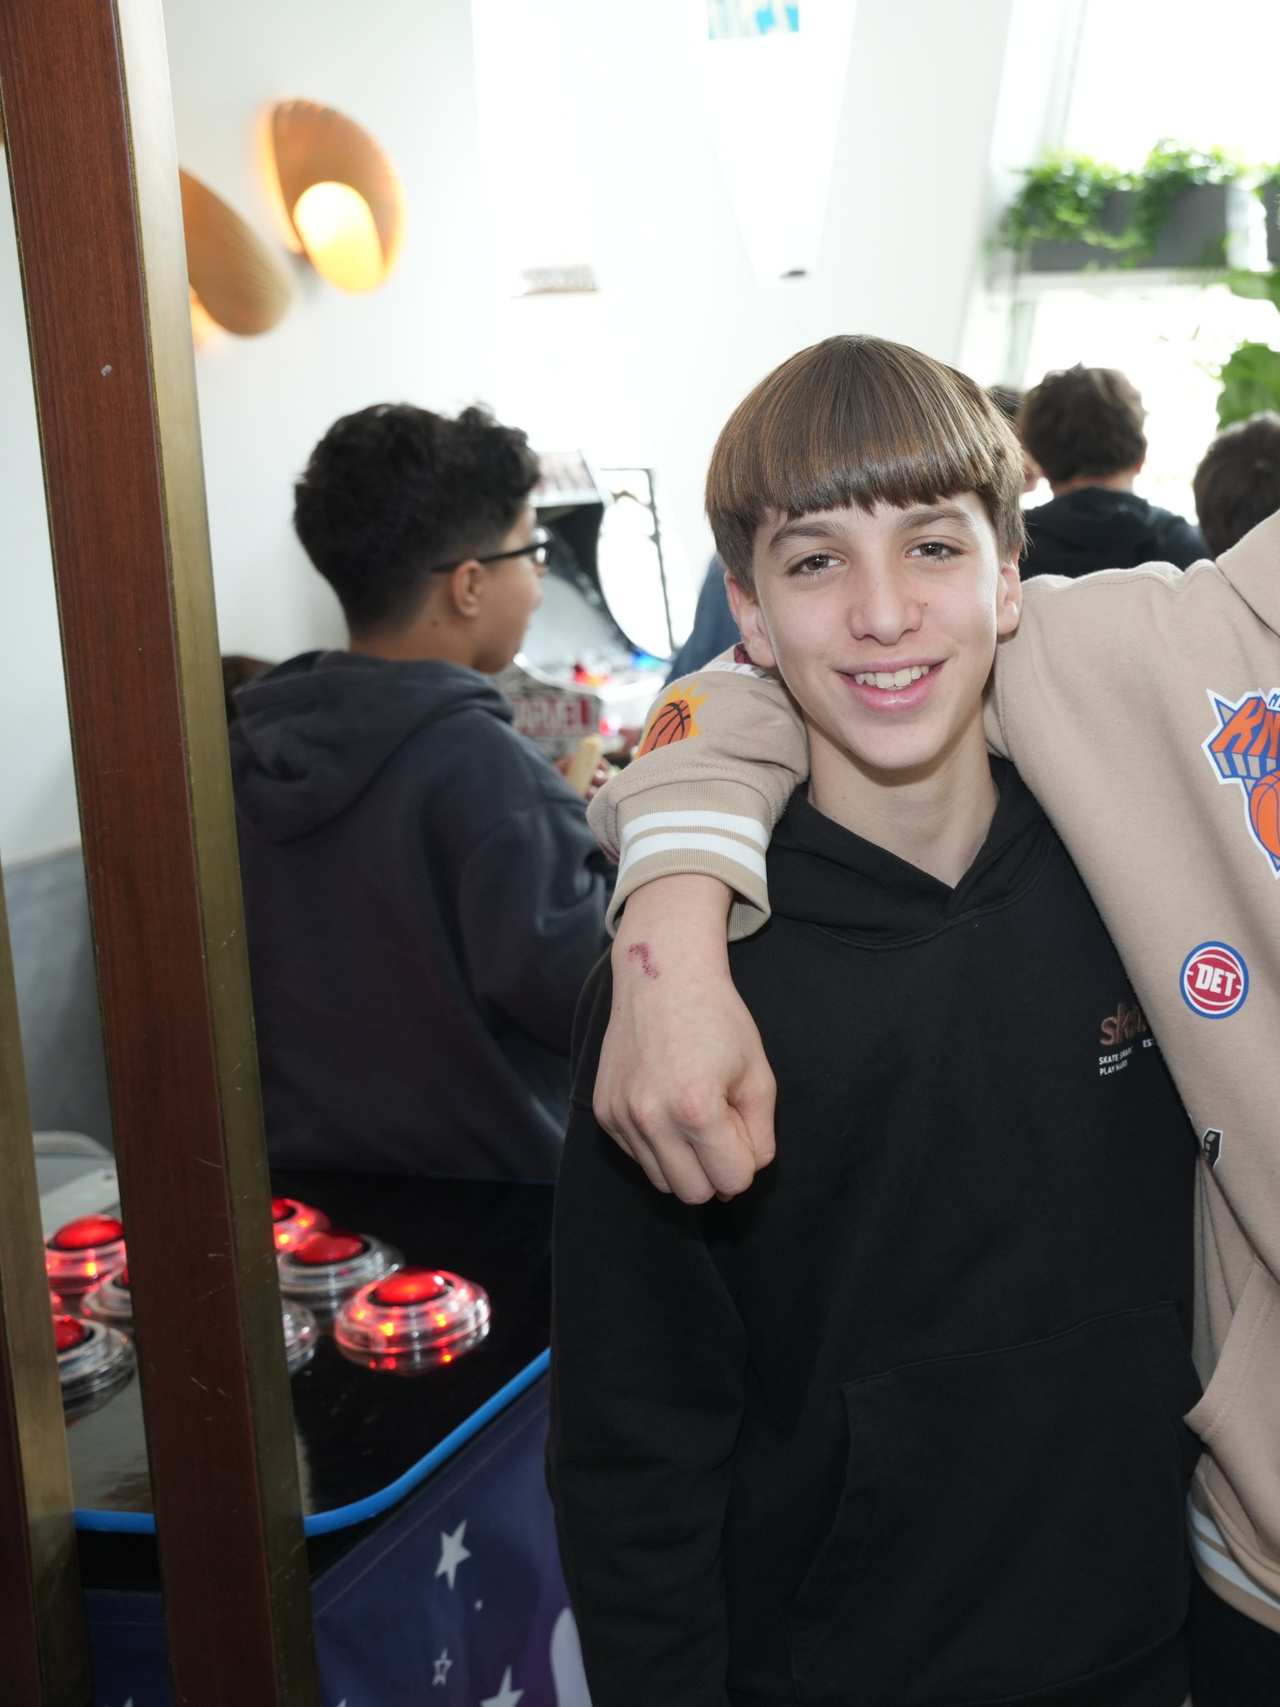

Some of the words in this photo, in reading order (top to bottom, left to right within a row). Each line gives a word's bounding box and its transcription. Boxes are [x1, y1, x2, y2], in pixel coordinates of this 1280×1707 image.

[1195, 963, 1237, 997] DET
[1099, 1053, 1119, 1065] SKATE
[1100, 1065, 1116, 1076] PLAY
